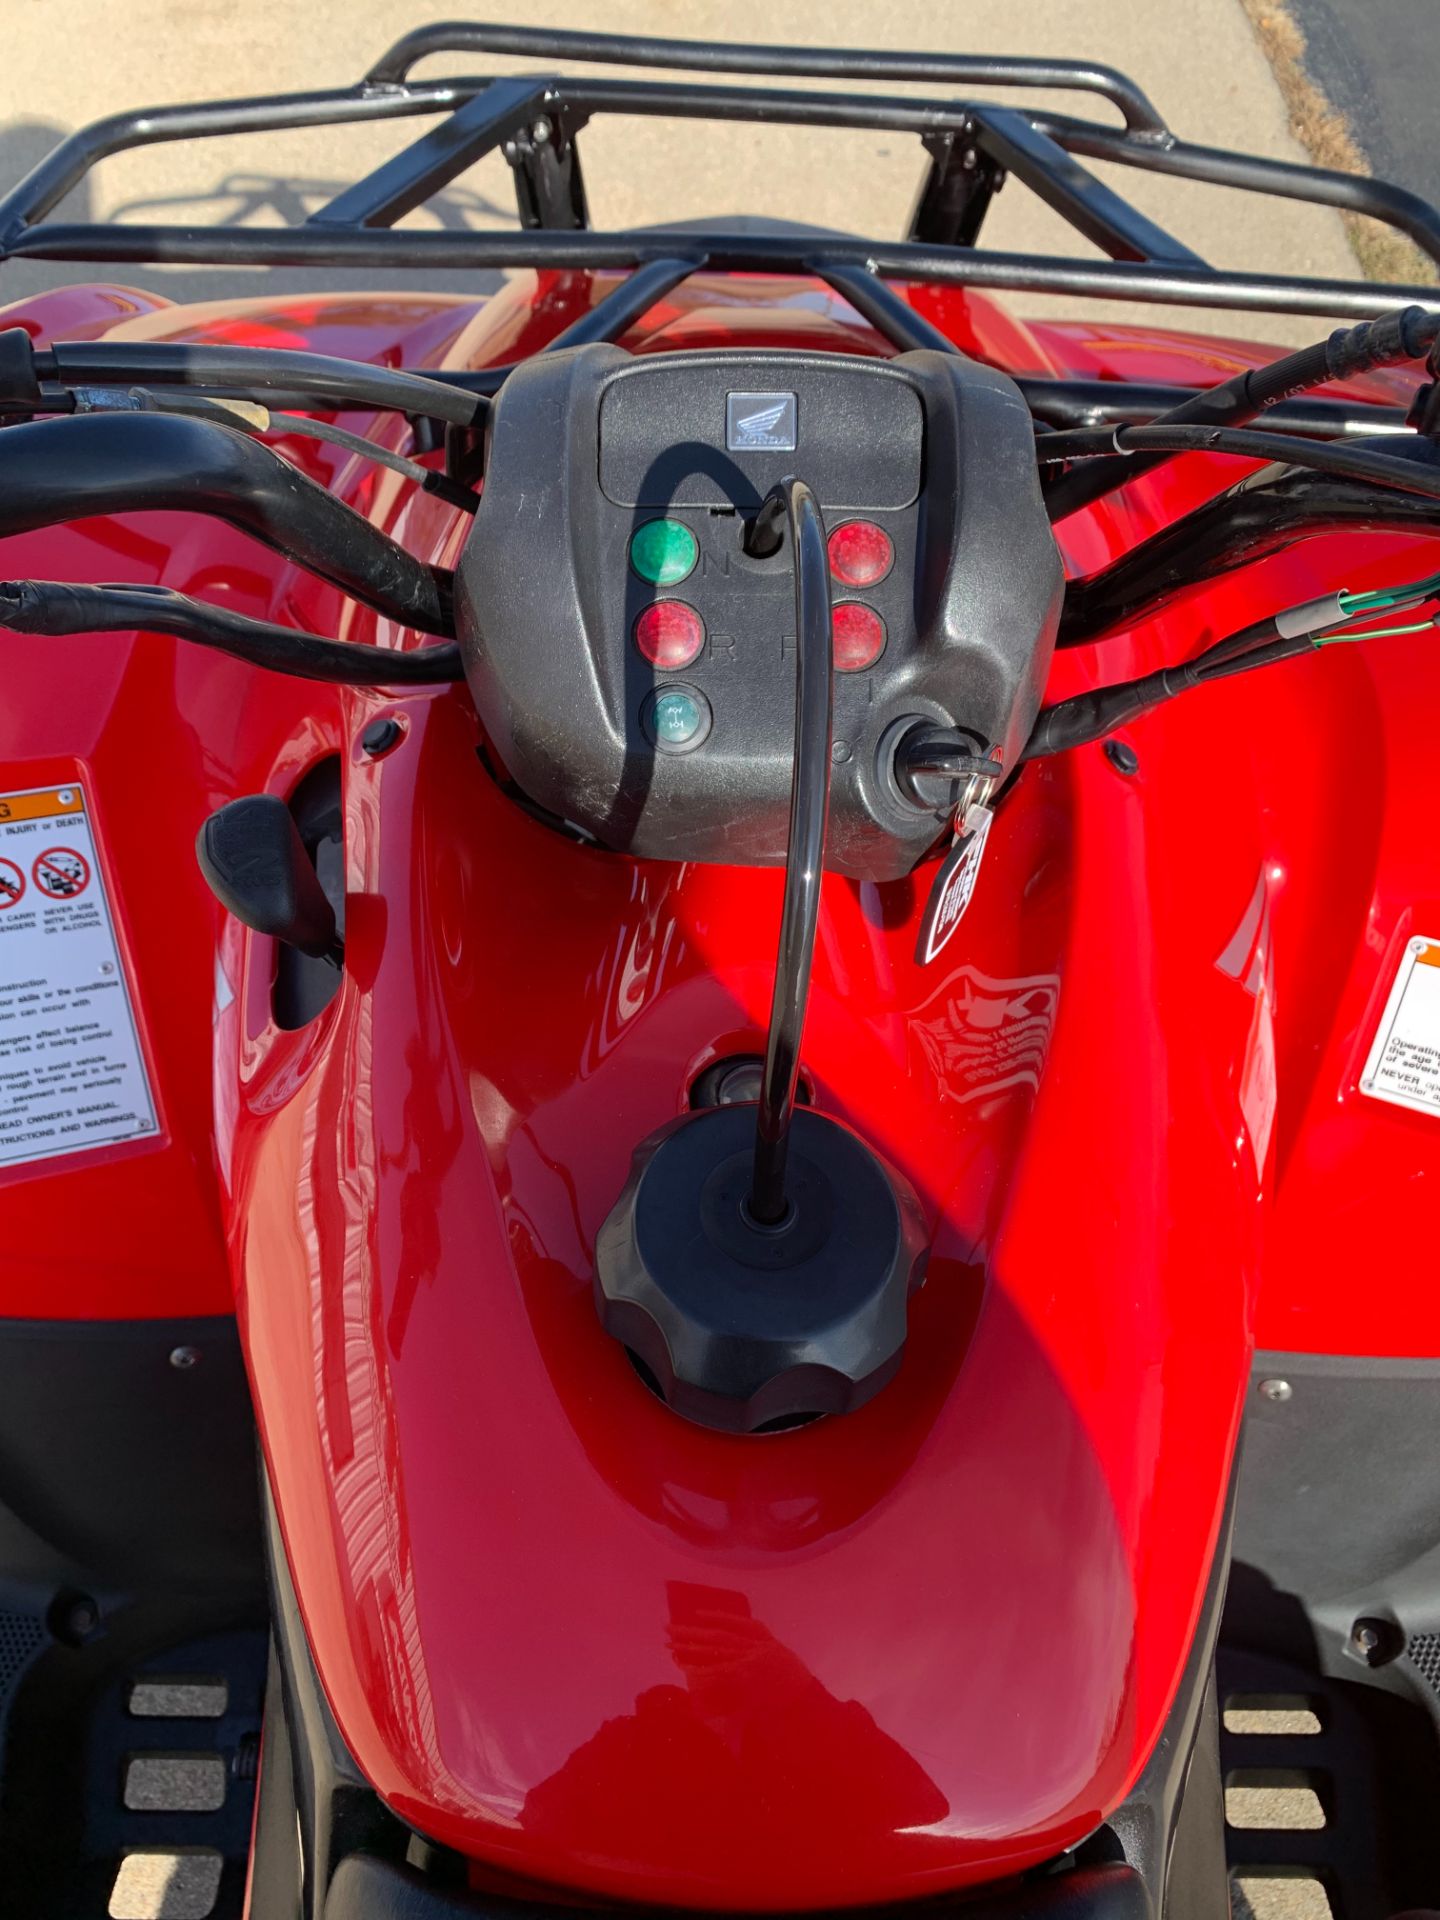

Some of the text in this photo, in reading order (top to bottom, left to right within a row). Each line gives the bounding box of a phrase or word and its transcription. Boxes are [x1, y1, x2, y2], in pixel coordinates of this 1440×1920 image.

[736, 434, 790, 445] HONDA
[701, 550, 730, 578] N
[709, 633, 736, 661] R
[5, 823, 37, 836] INJURY
[55, 816, 84, 828] DEATH
[7, 912, 36, 922] CARRY
[43, 911, 99, 925] WITH DRUGS
[44, 902, 94, 917] NEVER USE
[44, 919, 102, 935] OR ALCOHOL
[18, 994, 40, 1003] skills
[75, 980, 119, 993] conditions
[20, 1009, 37, 1017] can
[41, 1003, 67, 1013] occur
[72, 998, 91, 1008] with
[36, 1028, 61, 1039] affect
[65, 1022, 100, 1034] balance
[15, 1046, 31, 1054] risk
[36, 1042, 45, 1050] of
[50, 1037, 77, 1047] losing
[81, 1029, 113, 1041] control
[48, 1061, 72, 1072] avoid
[76, 1055, 107, 1066] vehicle
[1389, 1045, 1432, 1064] the age
[1385, 1055, 1439, 1075] of severe
[6, 1079, 33, 1090] rough
[37, 1074, 66, 1085] terrain
[70, 1069, 87, 1078] and
[103, 1063, 127, 1072] turns
[1380, 1067, 1421, 1085] NEVER
[12, 1088, 56, 1104] pavement
[60, 1086, 78, 1094] may
[83, 1076, 122, 1090] seriously
[1397, 1083, 1426, 1096] under
[26, 1109, 73, 1125] OWNER'S
[60, 1122, 81, 1134] AND
